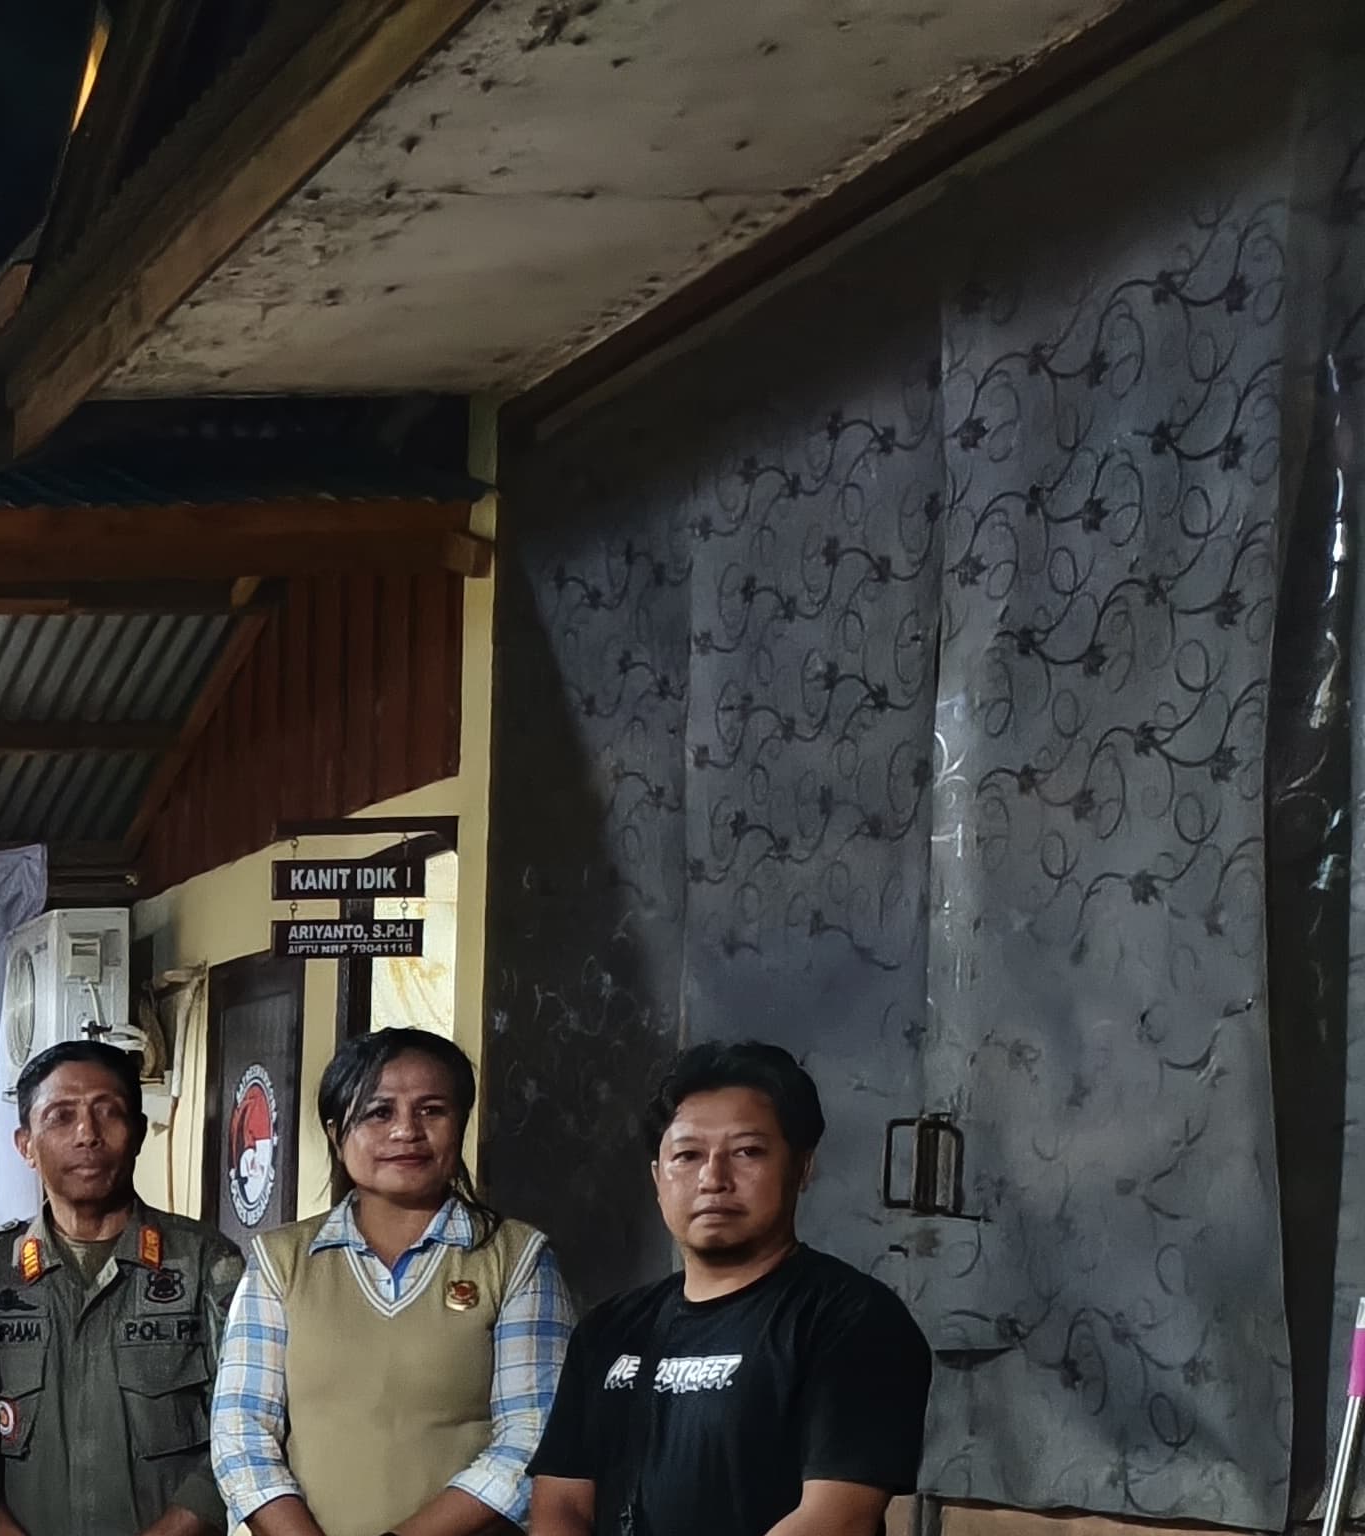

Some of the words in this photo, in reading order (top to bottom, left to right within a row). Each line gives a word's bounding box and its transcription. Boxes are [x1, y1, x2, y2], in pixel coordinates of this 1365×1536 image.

[290, 868, 351, 891] KANIT
[356, 867, 397, 890] IDIK
[288, 924, 369, 942] ARIYANTO,
[372, 923, 414, 939] S.Pd.I
[125, 1320, 172, 1342] POL
